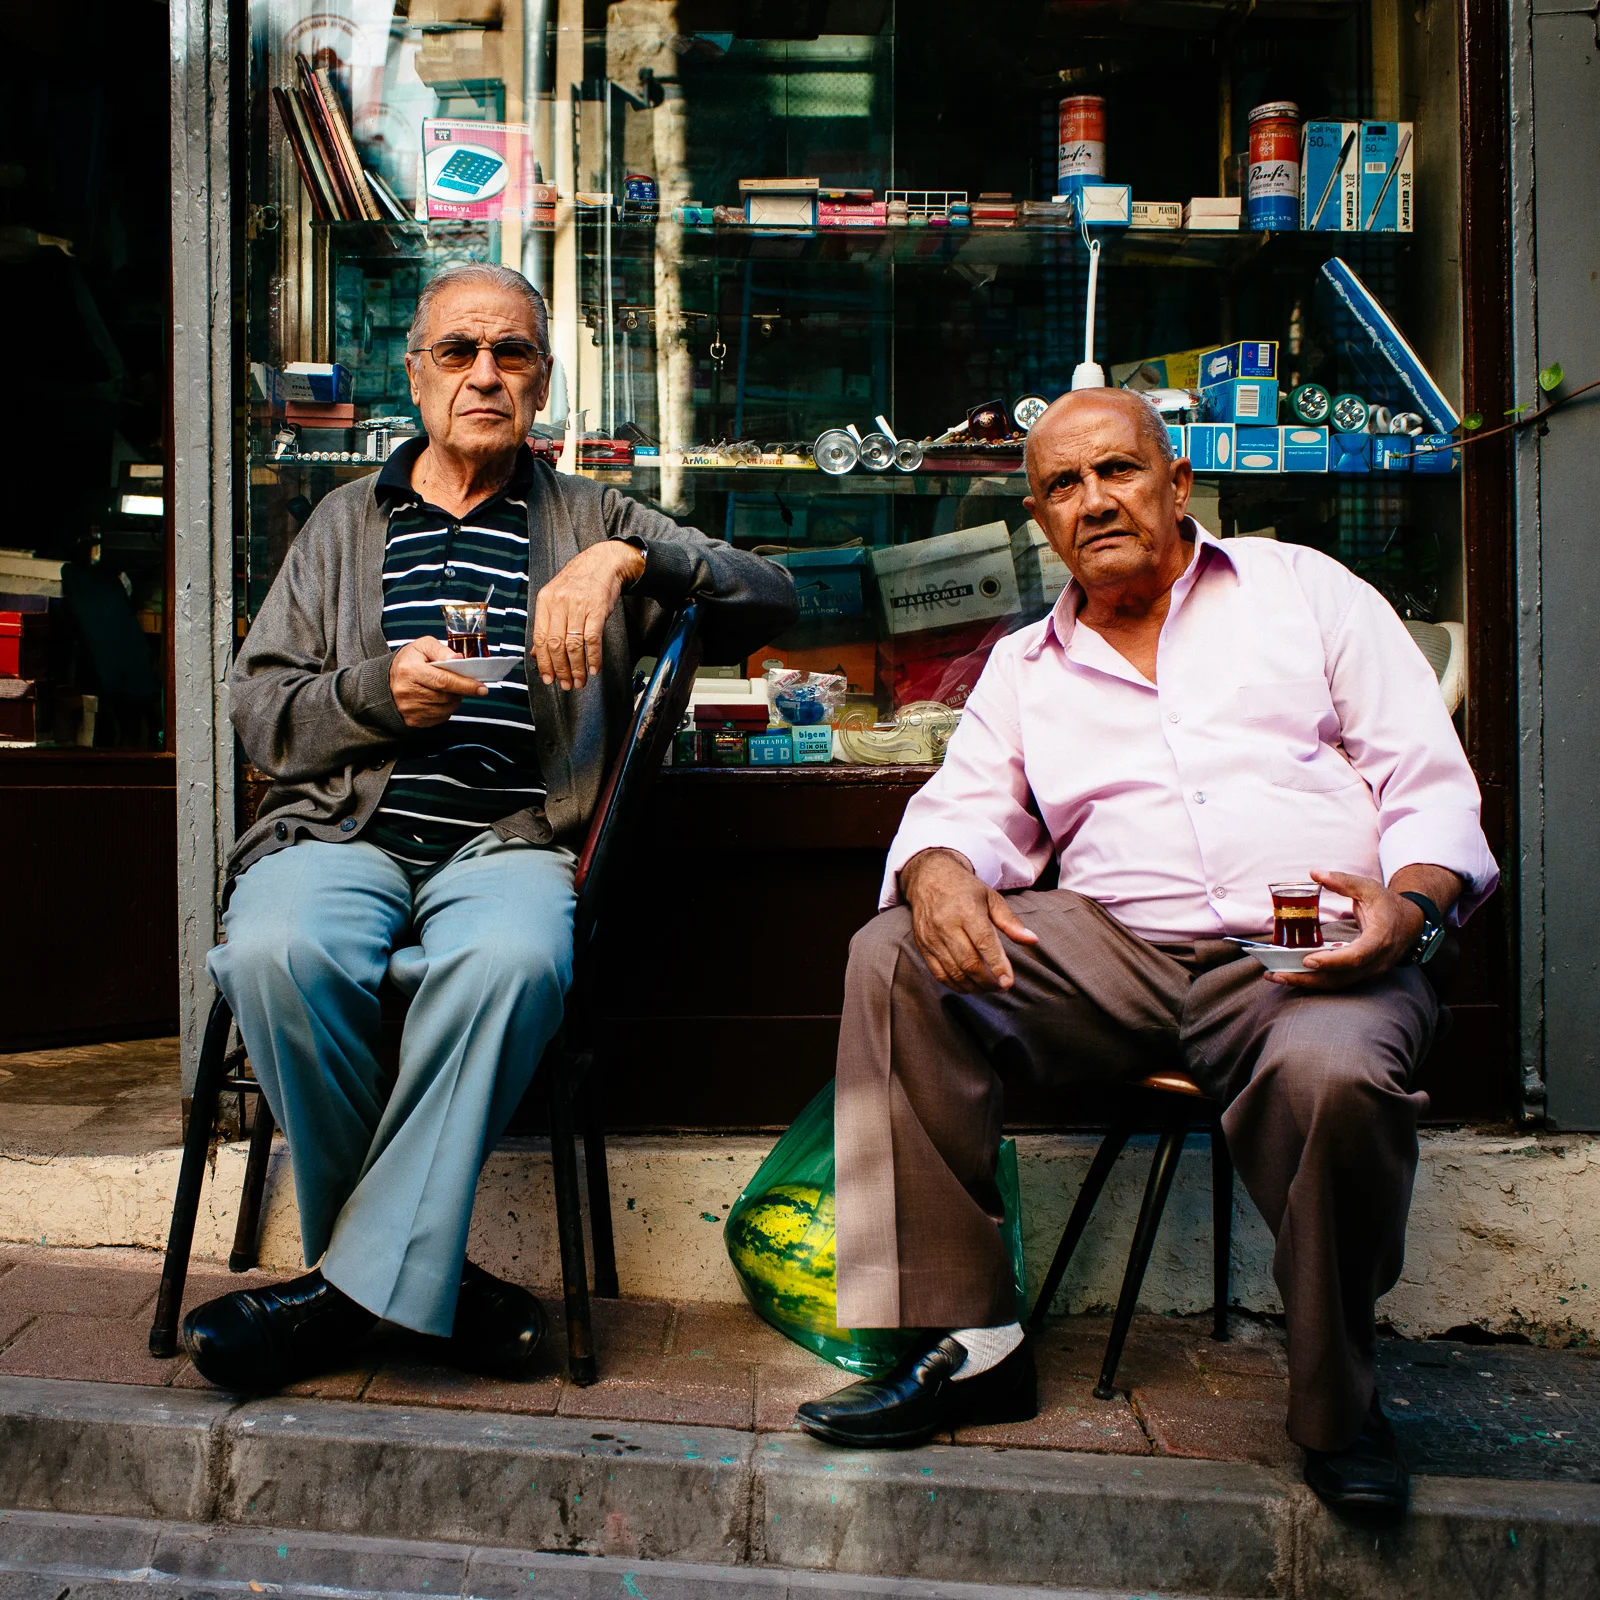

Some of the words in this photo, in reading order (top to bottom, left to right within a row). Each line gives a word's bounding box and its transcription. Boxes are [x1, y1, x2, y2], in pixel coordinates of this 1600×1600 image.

[1062, 112, 1097, 122] ADHESIVE
[1309, 137, 1324, 148] 50
[1365, 144, 1377, 152] 50
[1346, 191, 1354, 227] BEIFA
[1402, 190, 1410, 227] BEIFA
[760, 457, 784, 465] PASTEL
[898, 587, 968, 606] MARCOMEN
[799, 731, 826, 739] bigem
[750, 748, 790, 761] LED
